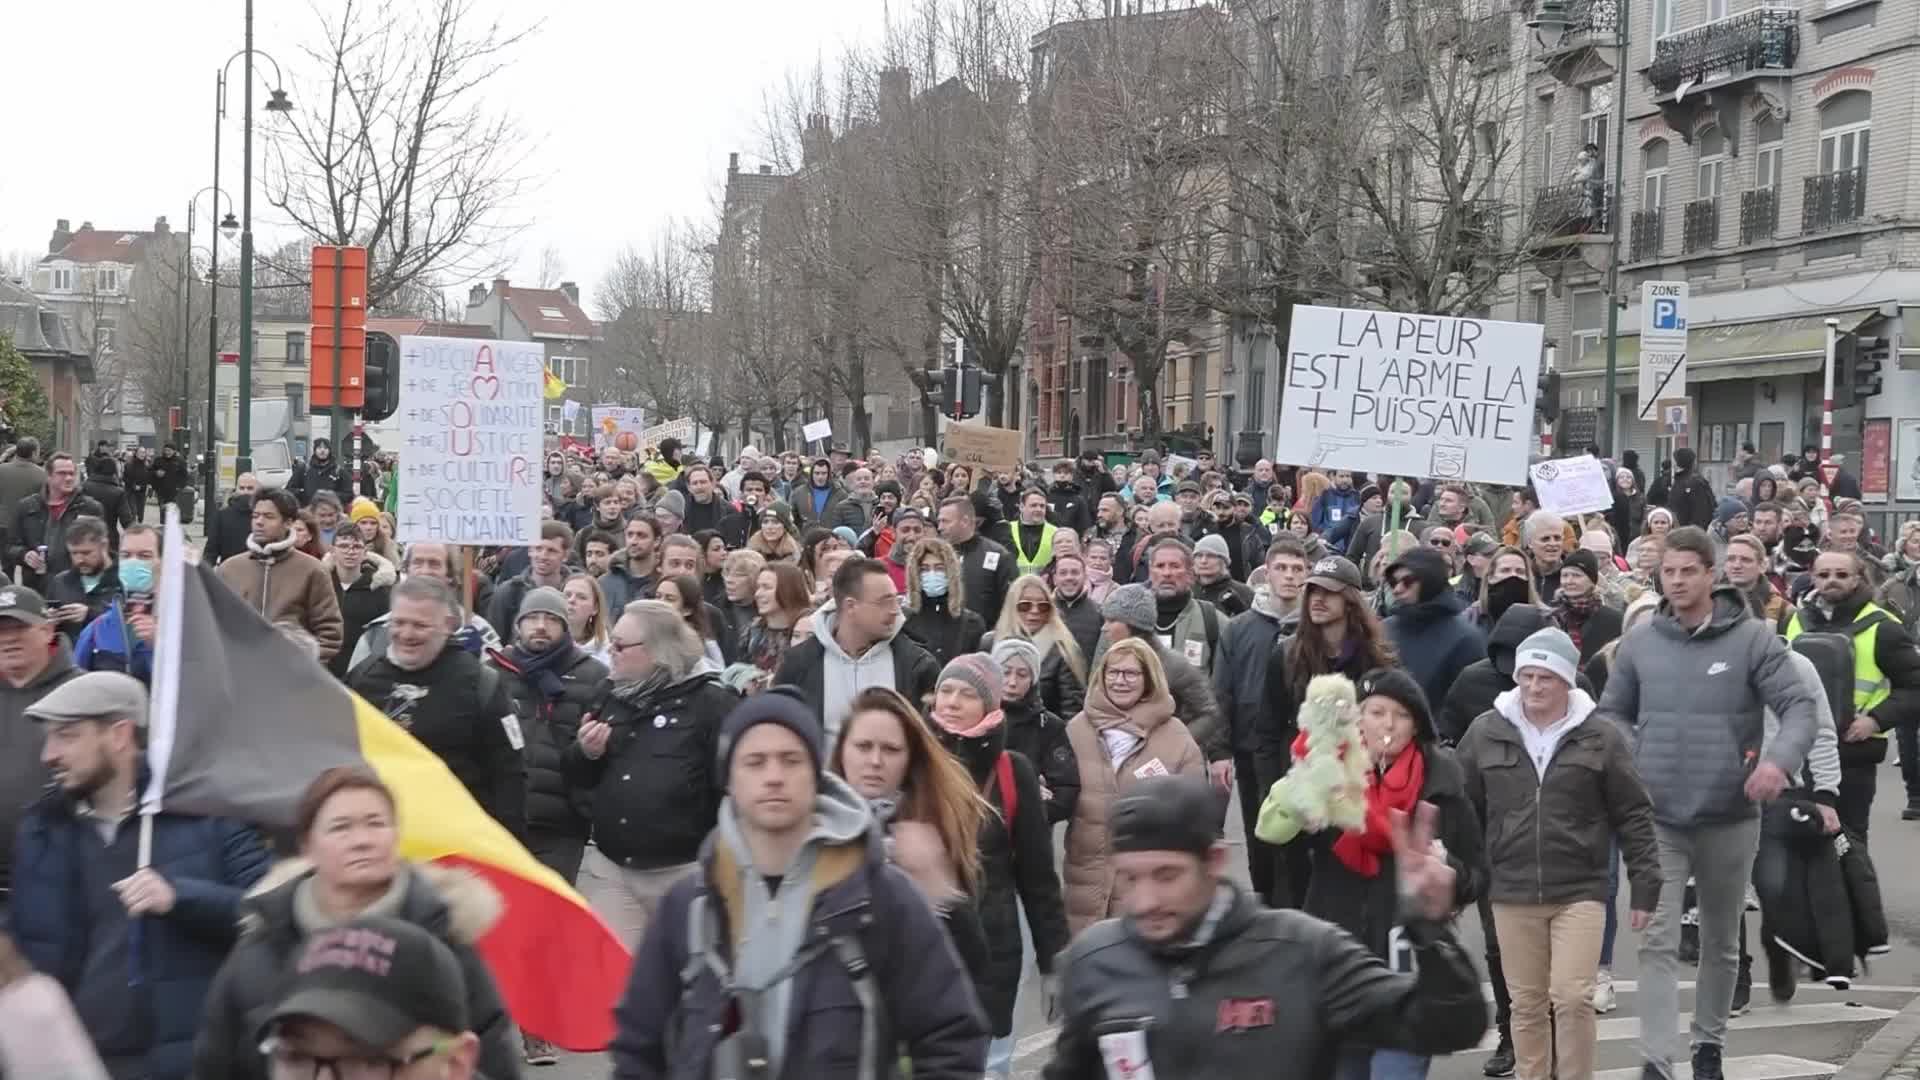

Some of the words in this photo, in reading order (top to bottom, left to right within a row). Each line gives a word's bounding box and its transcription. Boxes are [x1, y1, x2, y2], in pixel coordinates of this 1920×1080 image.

[1651, 285, 1681, 296] ZONE
[1338, 312, 1383, 349] LA
[1396, 317, 1483, 359] PEUR
[1648, 354, 1677, 364] ZONE
[421, 378, 439, 393] DE
[1288, 352, 1350, 391] EST
[1357, 357, 1474, 400] L'ARME
[1484, 365, 1528, 405] LA
[420, 407, 438, 424] DE
[1298, 391, 1337, 428] +
[420, 433, 436, 447] DE
[438, 429, 529, 457] JUSTICE
[420, 463, 438, 477] DE
[442, 456, 538, 487] CULTURE
[427, 515, 529, 542] HUMAINE
